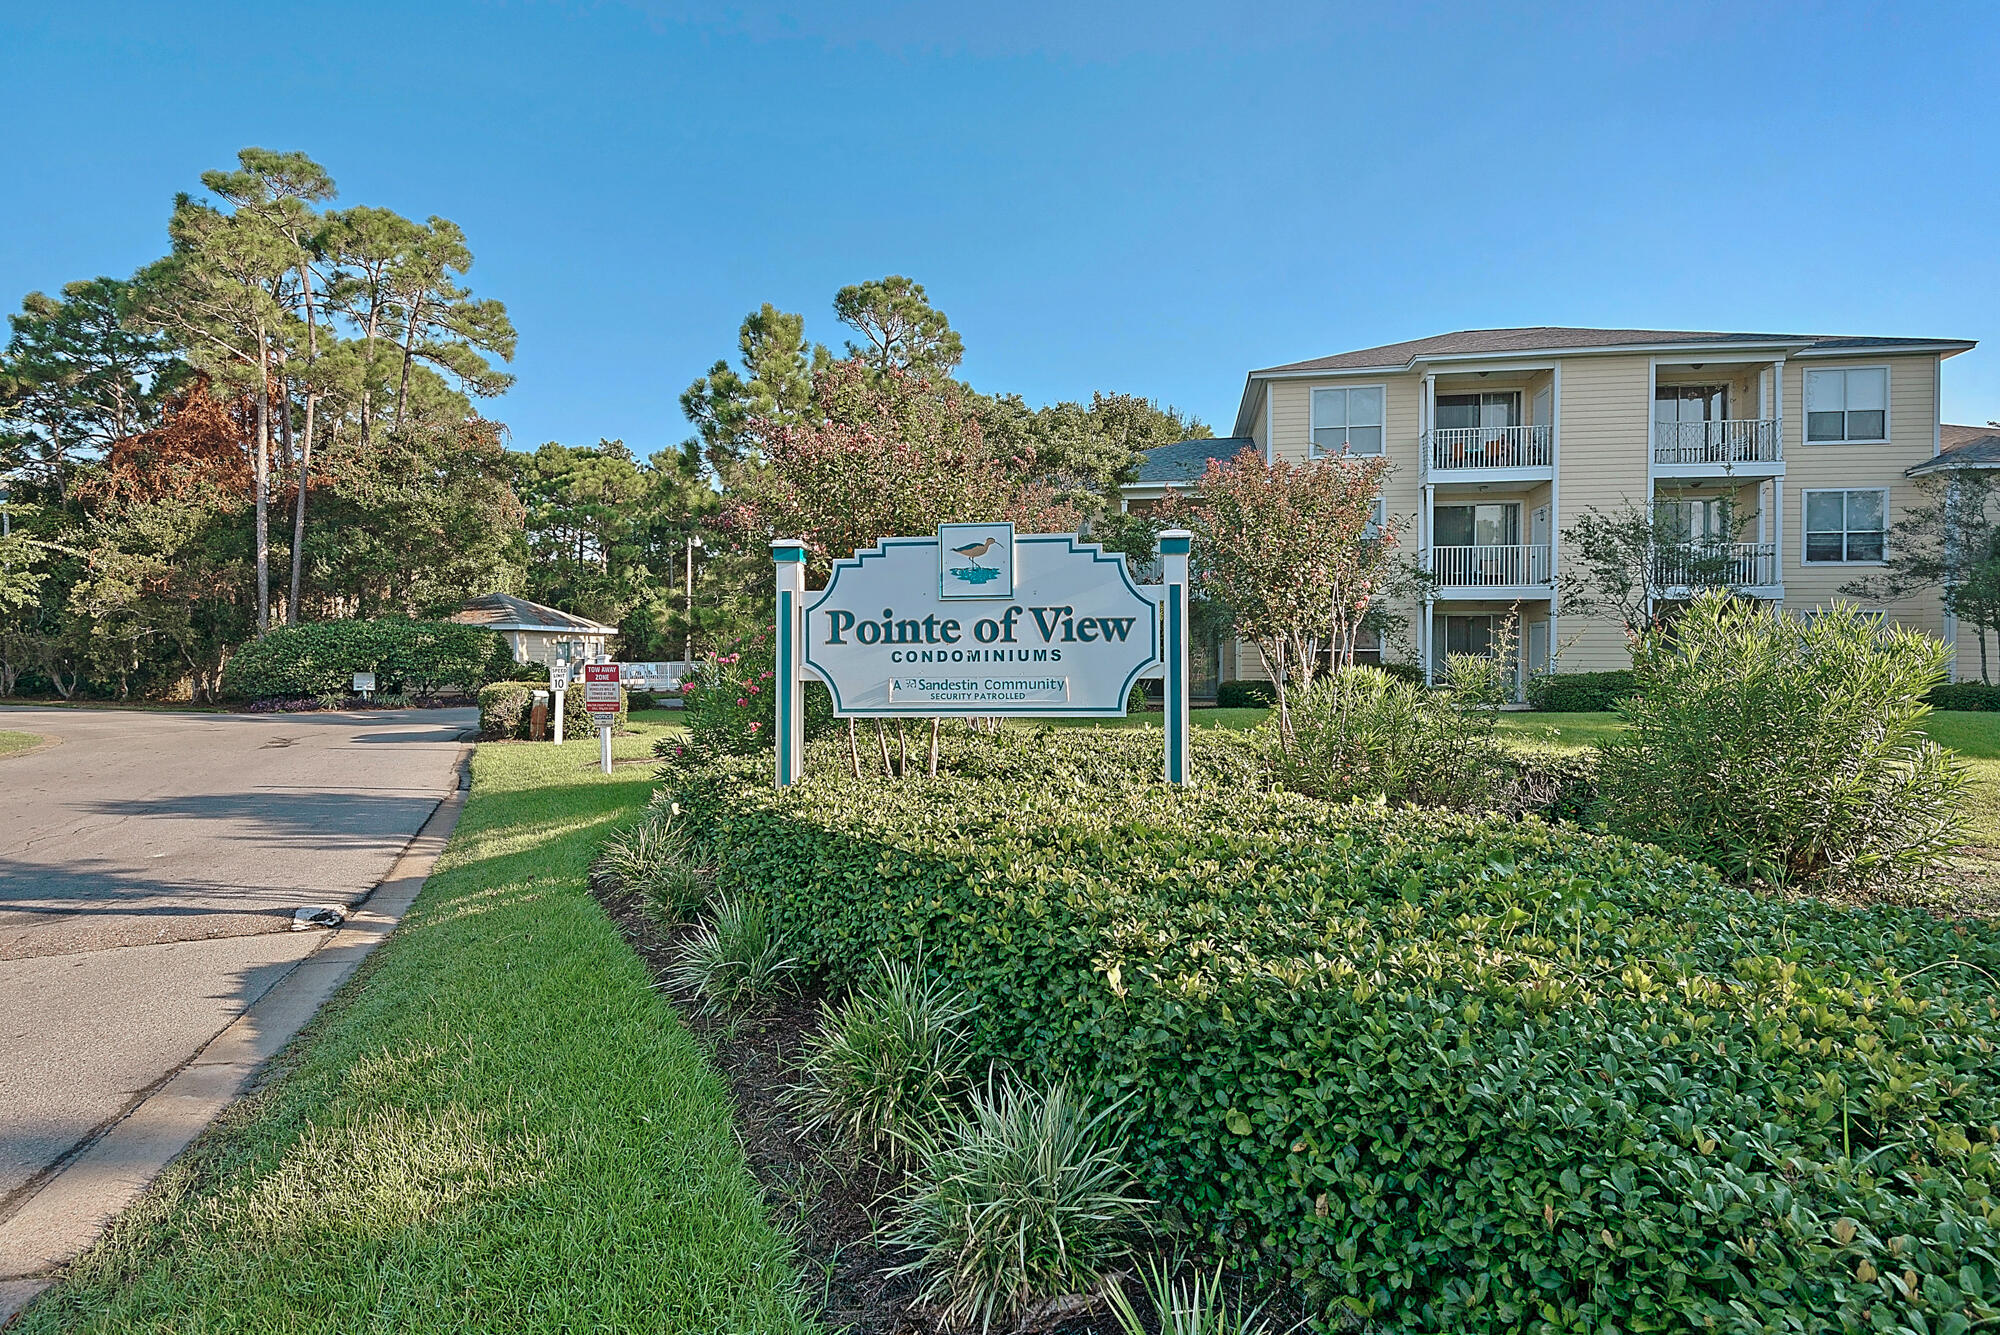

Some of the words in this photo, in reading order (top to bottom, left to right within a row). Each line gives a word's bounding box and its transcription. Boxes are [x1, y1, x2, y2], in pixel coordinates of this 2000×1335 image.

[825, 607, 962, 645] Pointe
[973, 605, 1024, 644] of
[1028, 605, 1137, 644] View
[891, 648, 1063, 664] CONDOMINIUMS
[554, 679, 564, 688] 10
[892, 680, 902, 691] A
[918, 678, 979, 691] Sandestin
[983, 677, 1065, 692] Community
[930, 692, 972, 701] SECURITY
[974, 692, 1026, 701] PATROLLED
